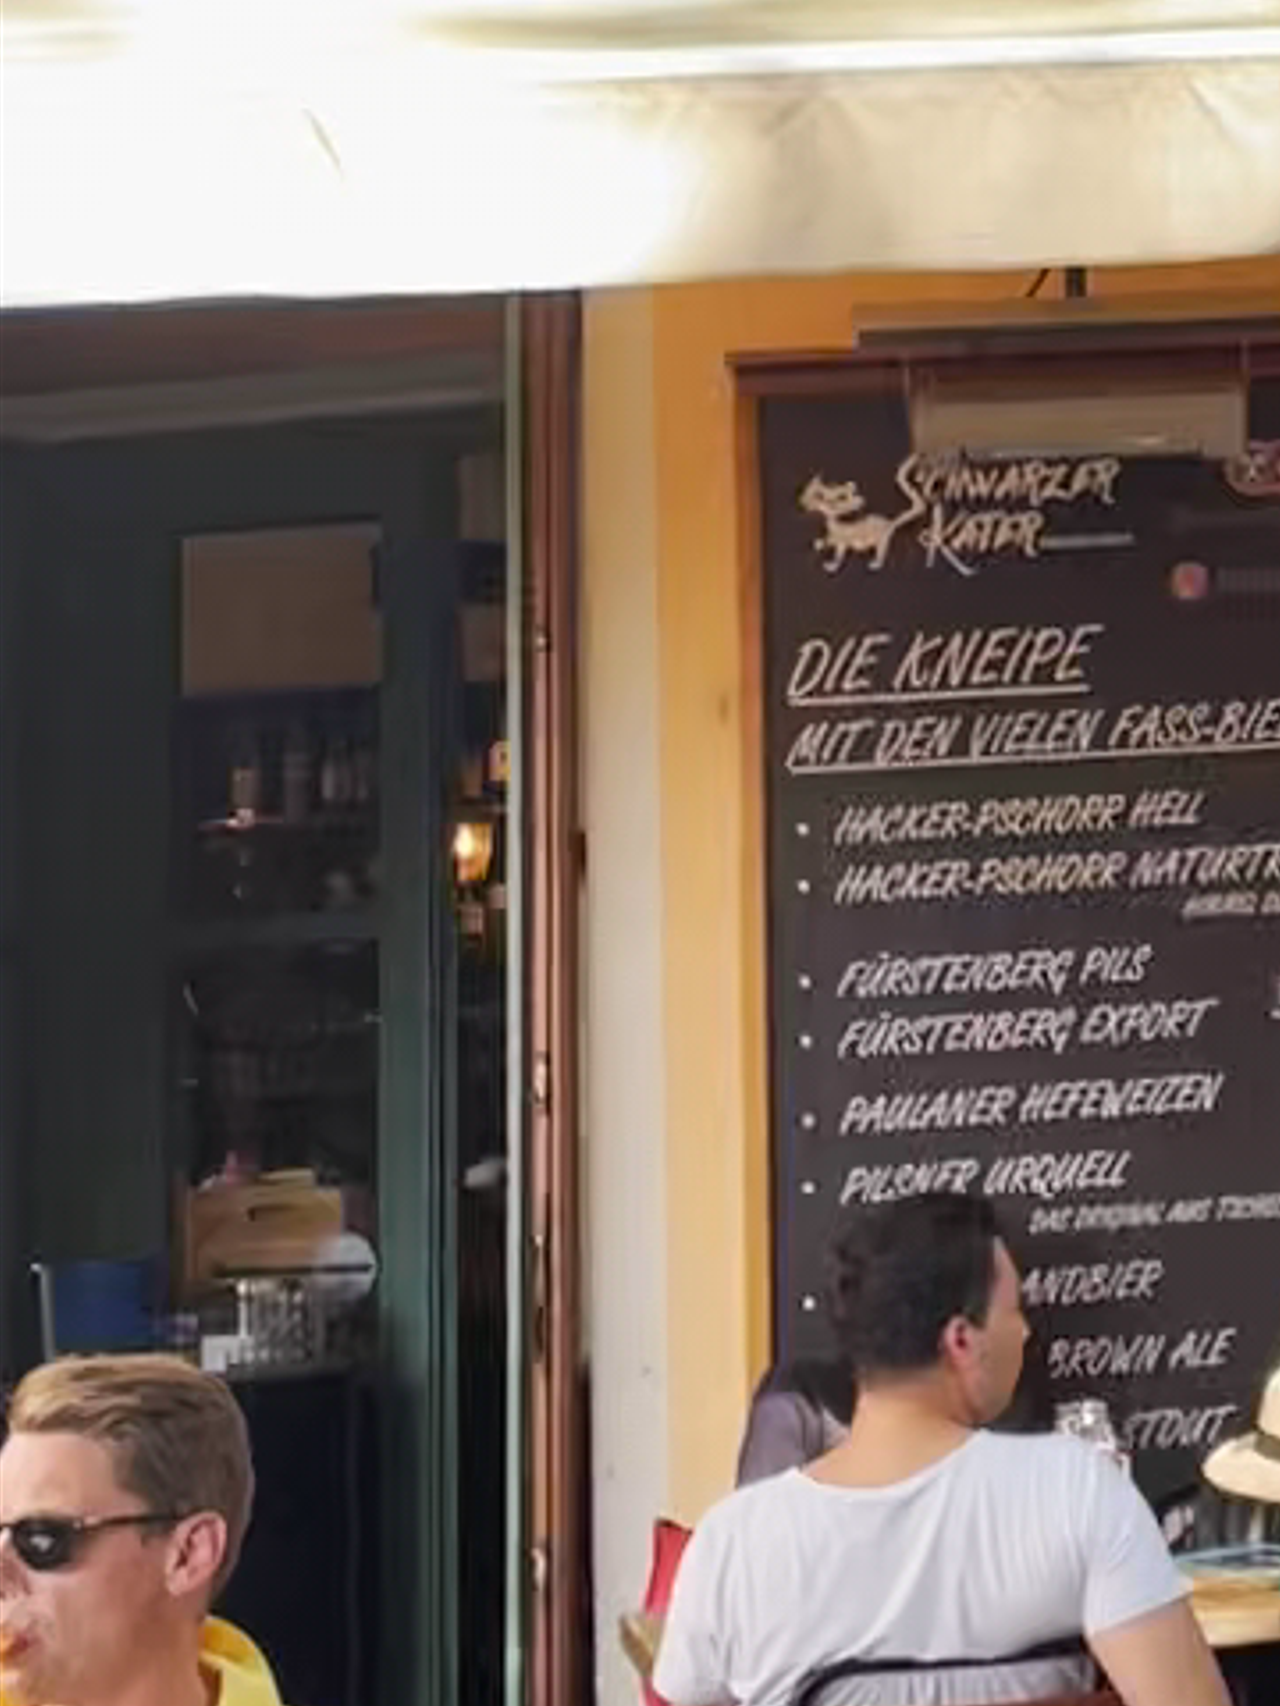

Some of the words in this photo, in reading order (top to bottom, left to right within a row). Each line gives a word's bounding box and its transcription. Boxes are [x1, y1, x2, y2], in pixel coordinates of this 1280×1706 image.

[918, 502, 1045, 576] KATER
[790, 634, 892, 696] DIE
[893, 624, 1104, 688] KNEIPE
[786, 719, 874, 769] MIT
[874, 714, 967, 766] DEN
[969, 708, 1105, 759] VIELEN
[834, 793, 1126, 845] HACKER-PSCHORR
[1129, 789, 1207, 828] HELL
[834, 852, 1127, 904] HACKER-PSCHORR
[837, 950, 1075, 998] FÜRSTENBERG
[1079, 944, 1153, 985] PILS
[837, 1006, 1076, 1058] FÜRSTENBERG
[1079, 997, 1221, 1044] EXPORT
[839, 1087, 1018, 1135] PAULANER
[1018, 1073, 1224, 1124] HEFEWEIZEN
[839, 1159, 979, 1205] PILSNER
[983, 1150, 1132, 1199] URQUELL
[1021, 1259, 1164, 1305] ANDBIER
[1048, 1334, 1165, 1380] BROWN
[1167, 1328, 1238, 1370] ALE
[1122, 1404, 1240, 1450] STOUT
